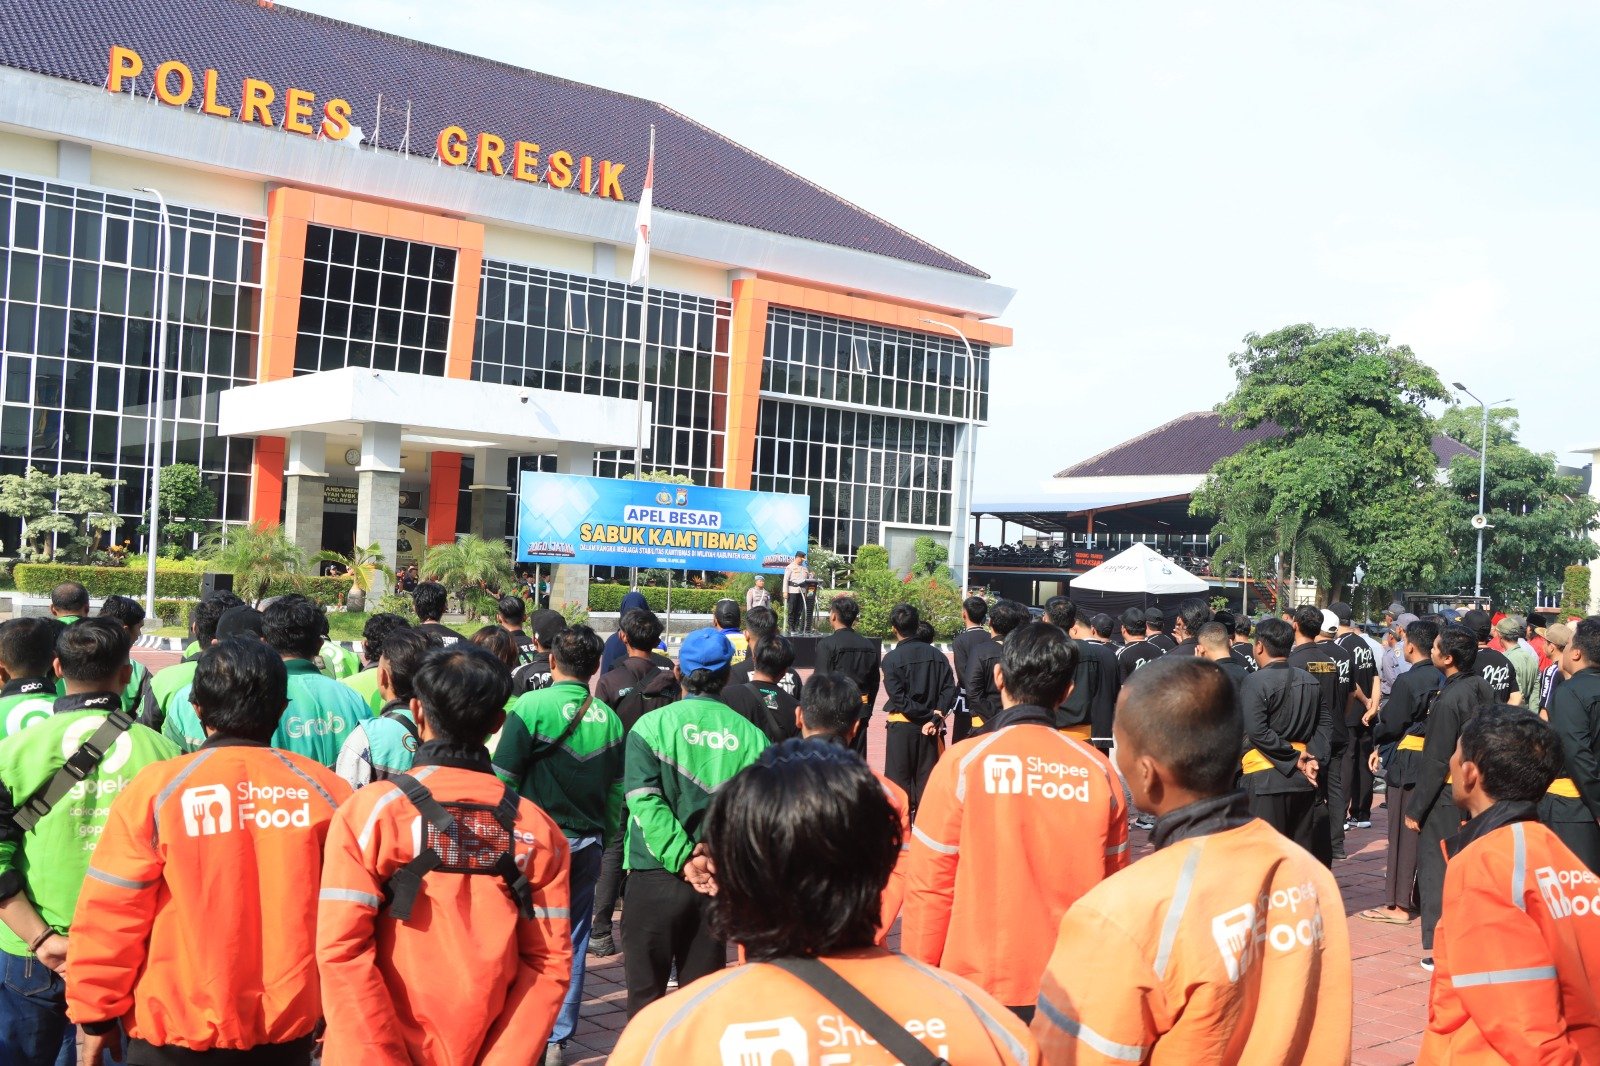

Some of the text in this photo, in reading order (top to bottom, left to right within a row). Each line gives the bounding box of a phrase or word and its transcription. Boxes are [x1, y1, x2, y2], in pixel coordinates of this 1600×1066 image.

[108, 45, 626, 201] POLRES GRESIK
[627, 508, 719, 527] APEL BESAR
[580, 523, 758, 552] SABUK KAMTIBMAS
[617, 546, 639, 554] MENJAGA
[21, 682, 43, 692] goto
[84, 698, 109, 706] goto
[562, 702, 608, 723] Gab
[286, 711, 346, 739] Grab
[682, 723, 740, 752] Grab
[1026, 756, 1089, 778] Shopee
[236, 781, 309, 805] Shopee
[1026, 774, 1089, 803] Food
[238, 802, 310, 830] Food
[816, 1014, 947, 1048] Shee
